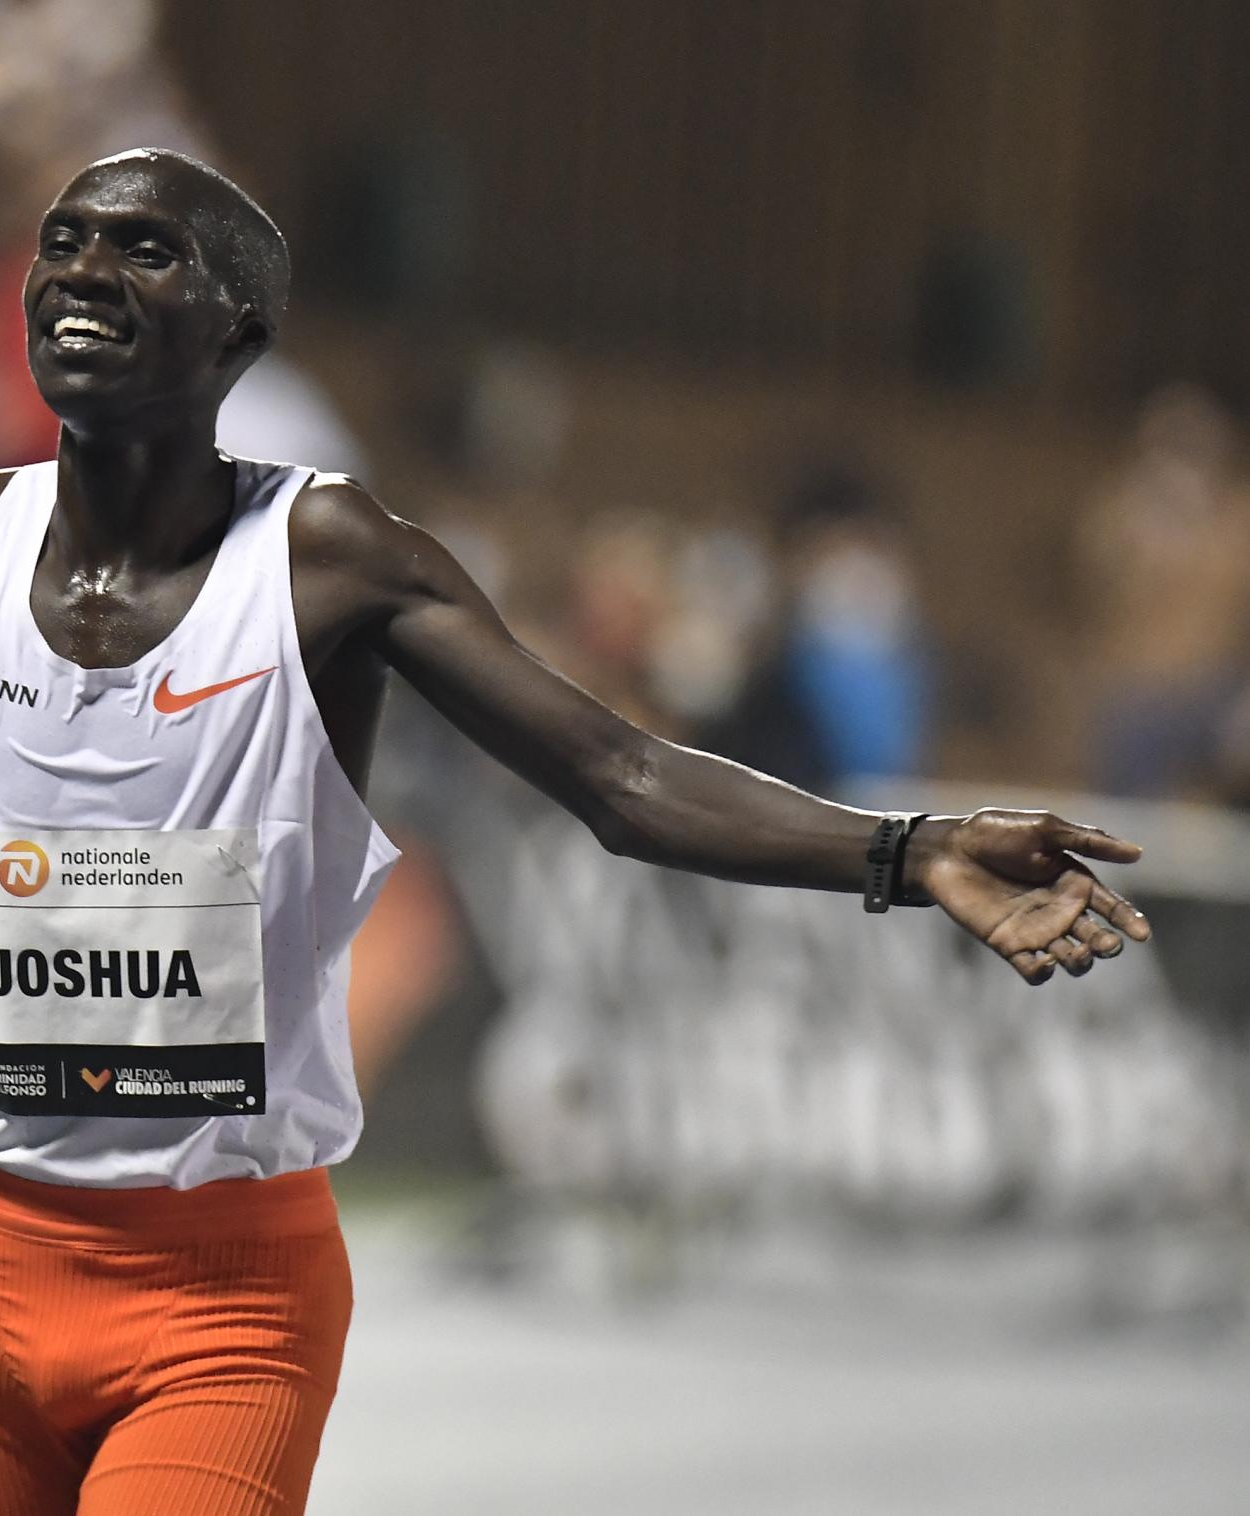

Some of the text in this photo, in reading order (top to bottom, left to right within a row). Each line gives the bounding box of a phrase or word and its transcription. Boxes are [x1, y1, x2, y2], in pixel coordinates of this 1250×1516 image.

[61, 848, 151, 865] nationale
[61, 869, 183, 886] nederlanden
[114, 1067, 172, 1081] VALENCIA
[115, 1080, 162, 1095] CIUDAD
[163, 1081, 187, 1095] DEL
